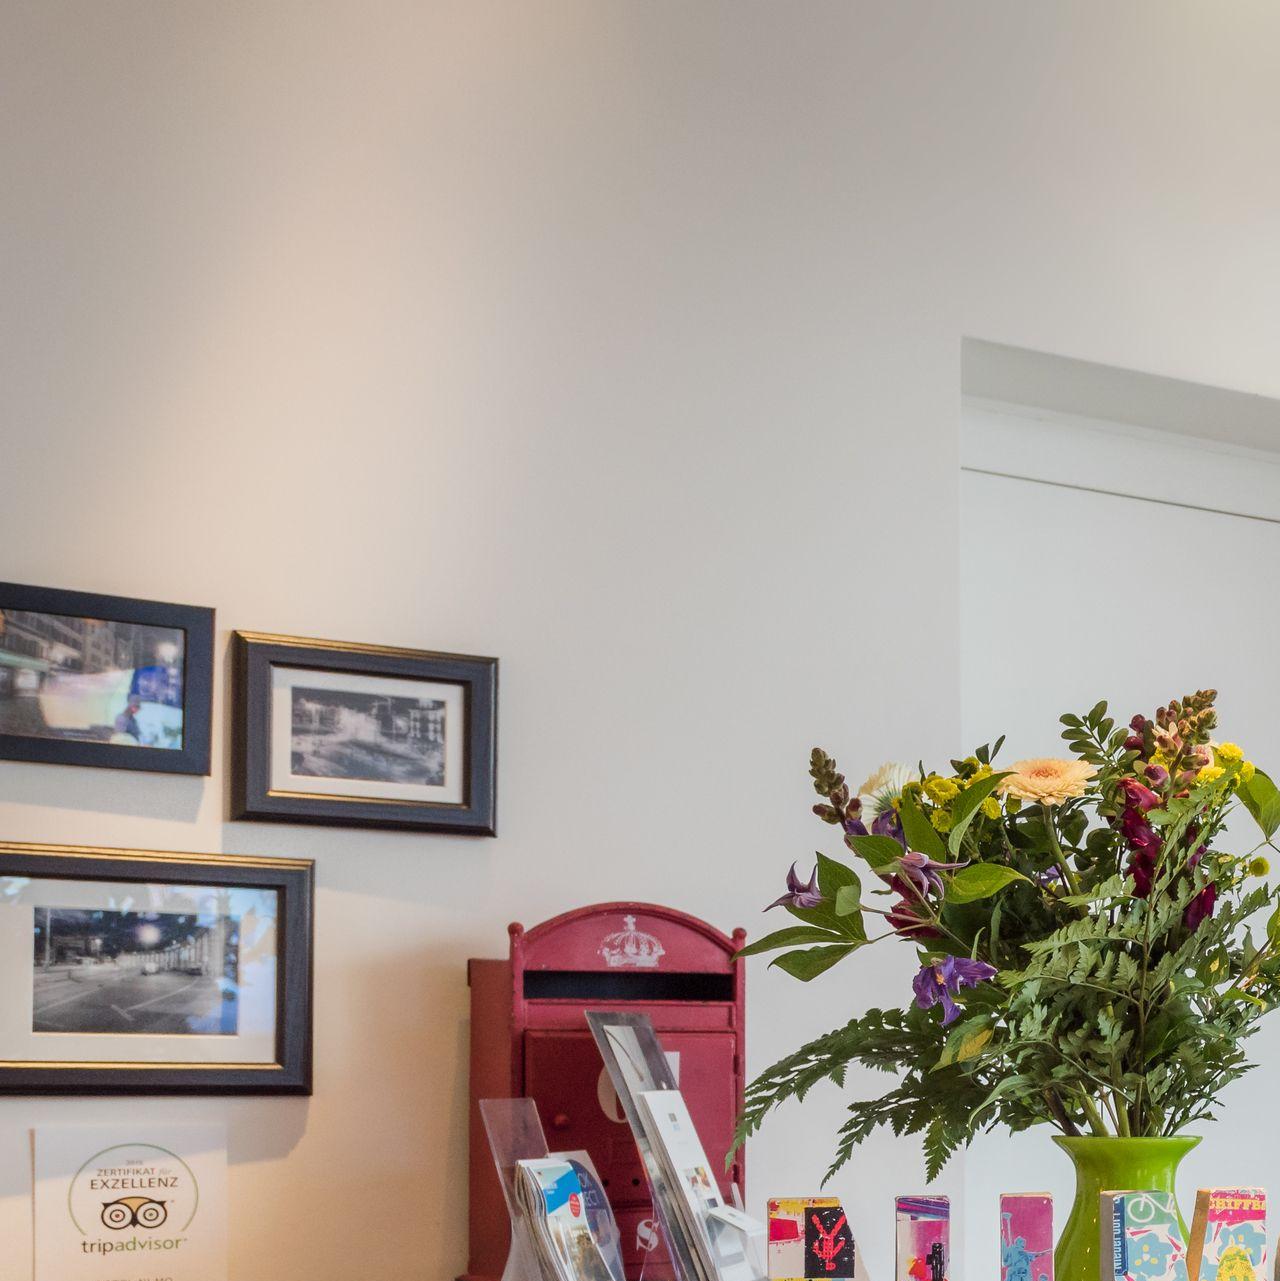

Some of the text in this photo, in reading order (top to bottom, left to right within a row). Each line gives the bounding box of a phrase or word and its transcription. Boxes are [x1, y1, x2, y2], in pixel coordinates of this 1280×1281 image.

[97, 1168, 156, 1176] ZERTIFIKAT
[90, 1177, 179, 1190] EXZELLENZ
[81, 1236, 183, 1256] tripadvisor
